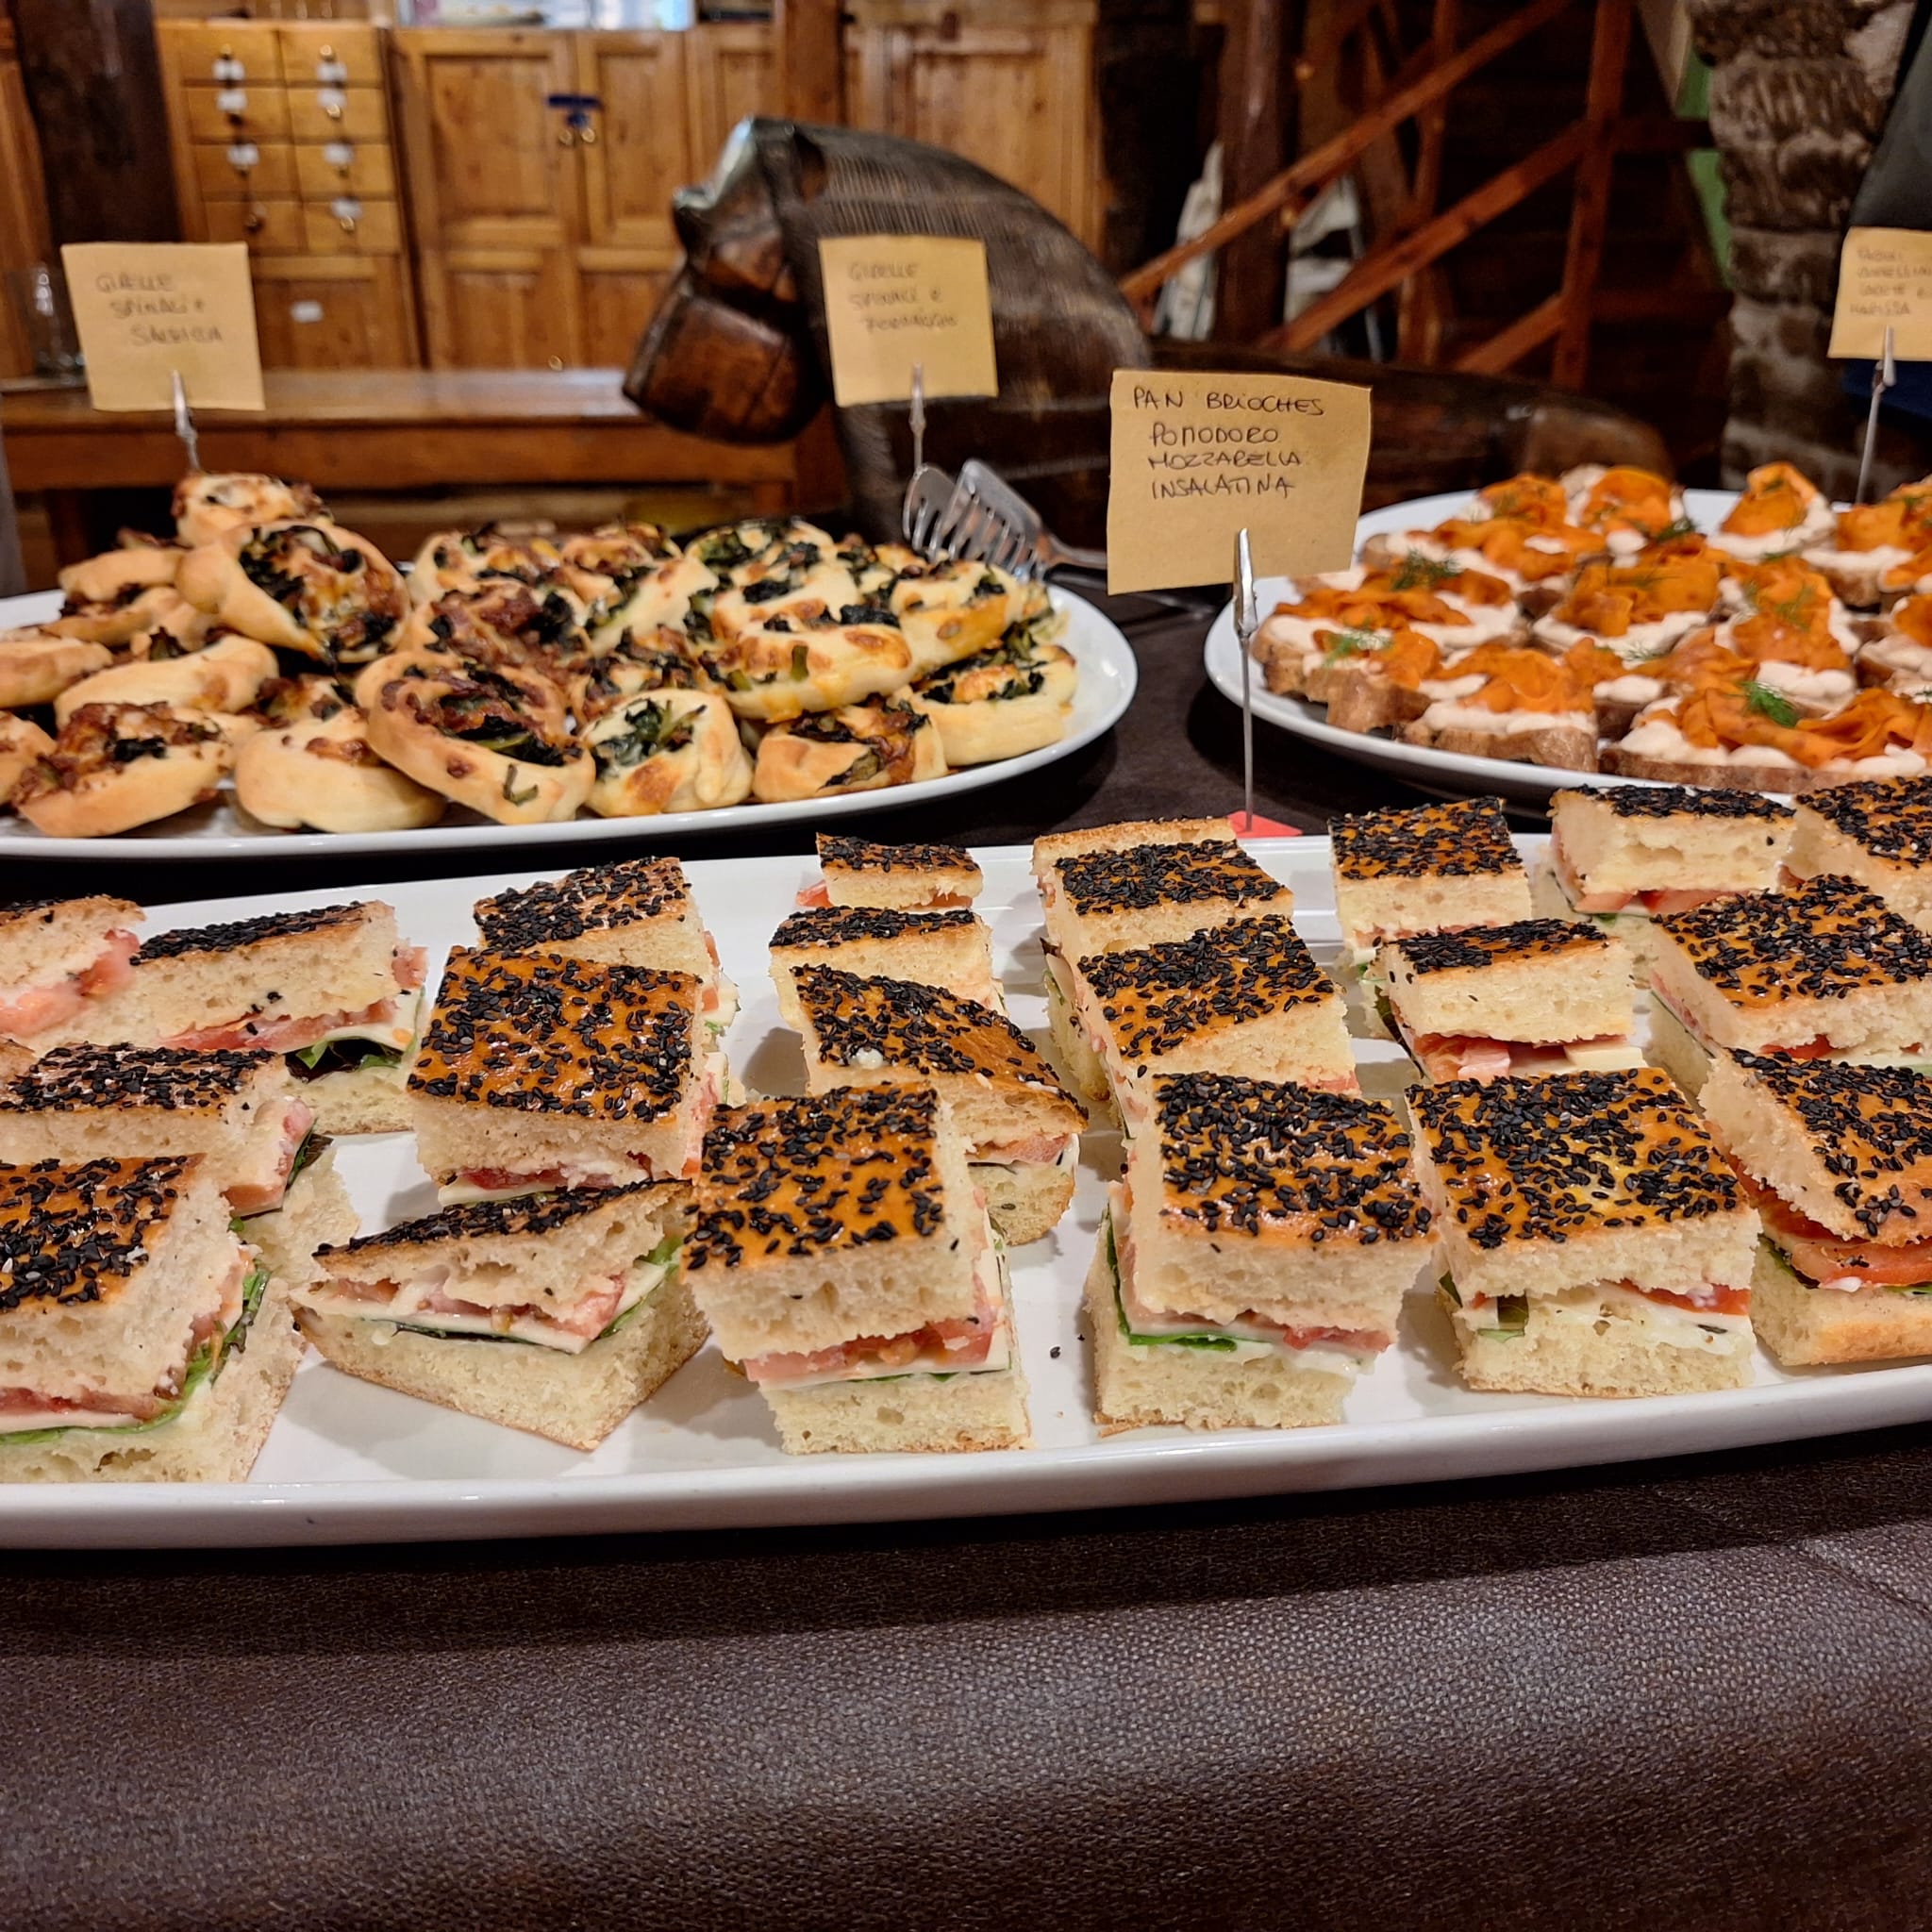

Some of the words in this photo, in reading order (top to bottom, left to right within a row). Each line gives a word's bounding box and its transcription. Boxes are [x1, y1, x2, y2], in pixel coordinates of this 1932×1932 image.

[1133, 385, 1184, 410] PAN
[1149, 421, 1279, 447] POMODORO
[1148, 450, 1302, 471] MOZZARELLA
[1152, 473, 1296, 499] INSALATINA
